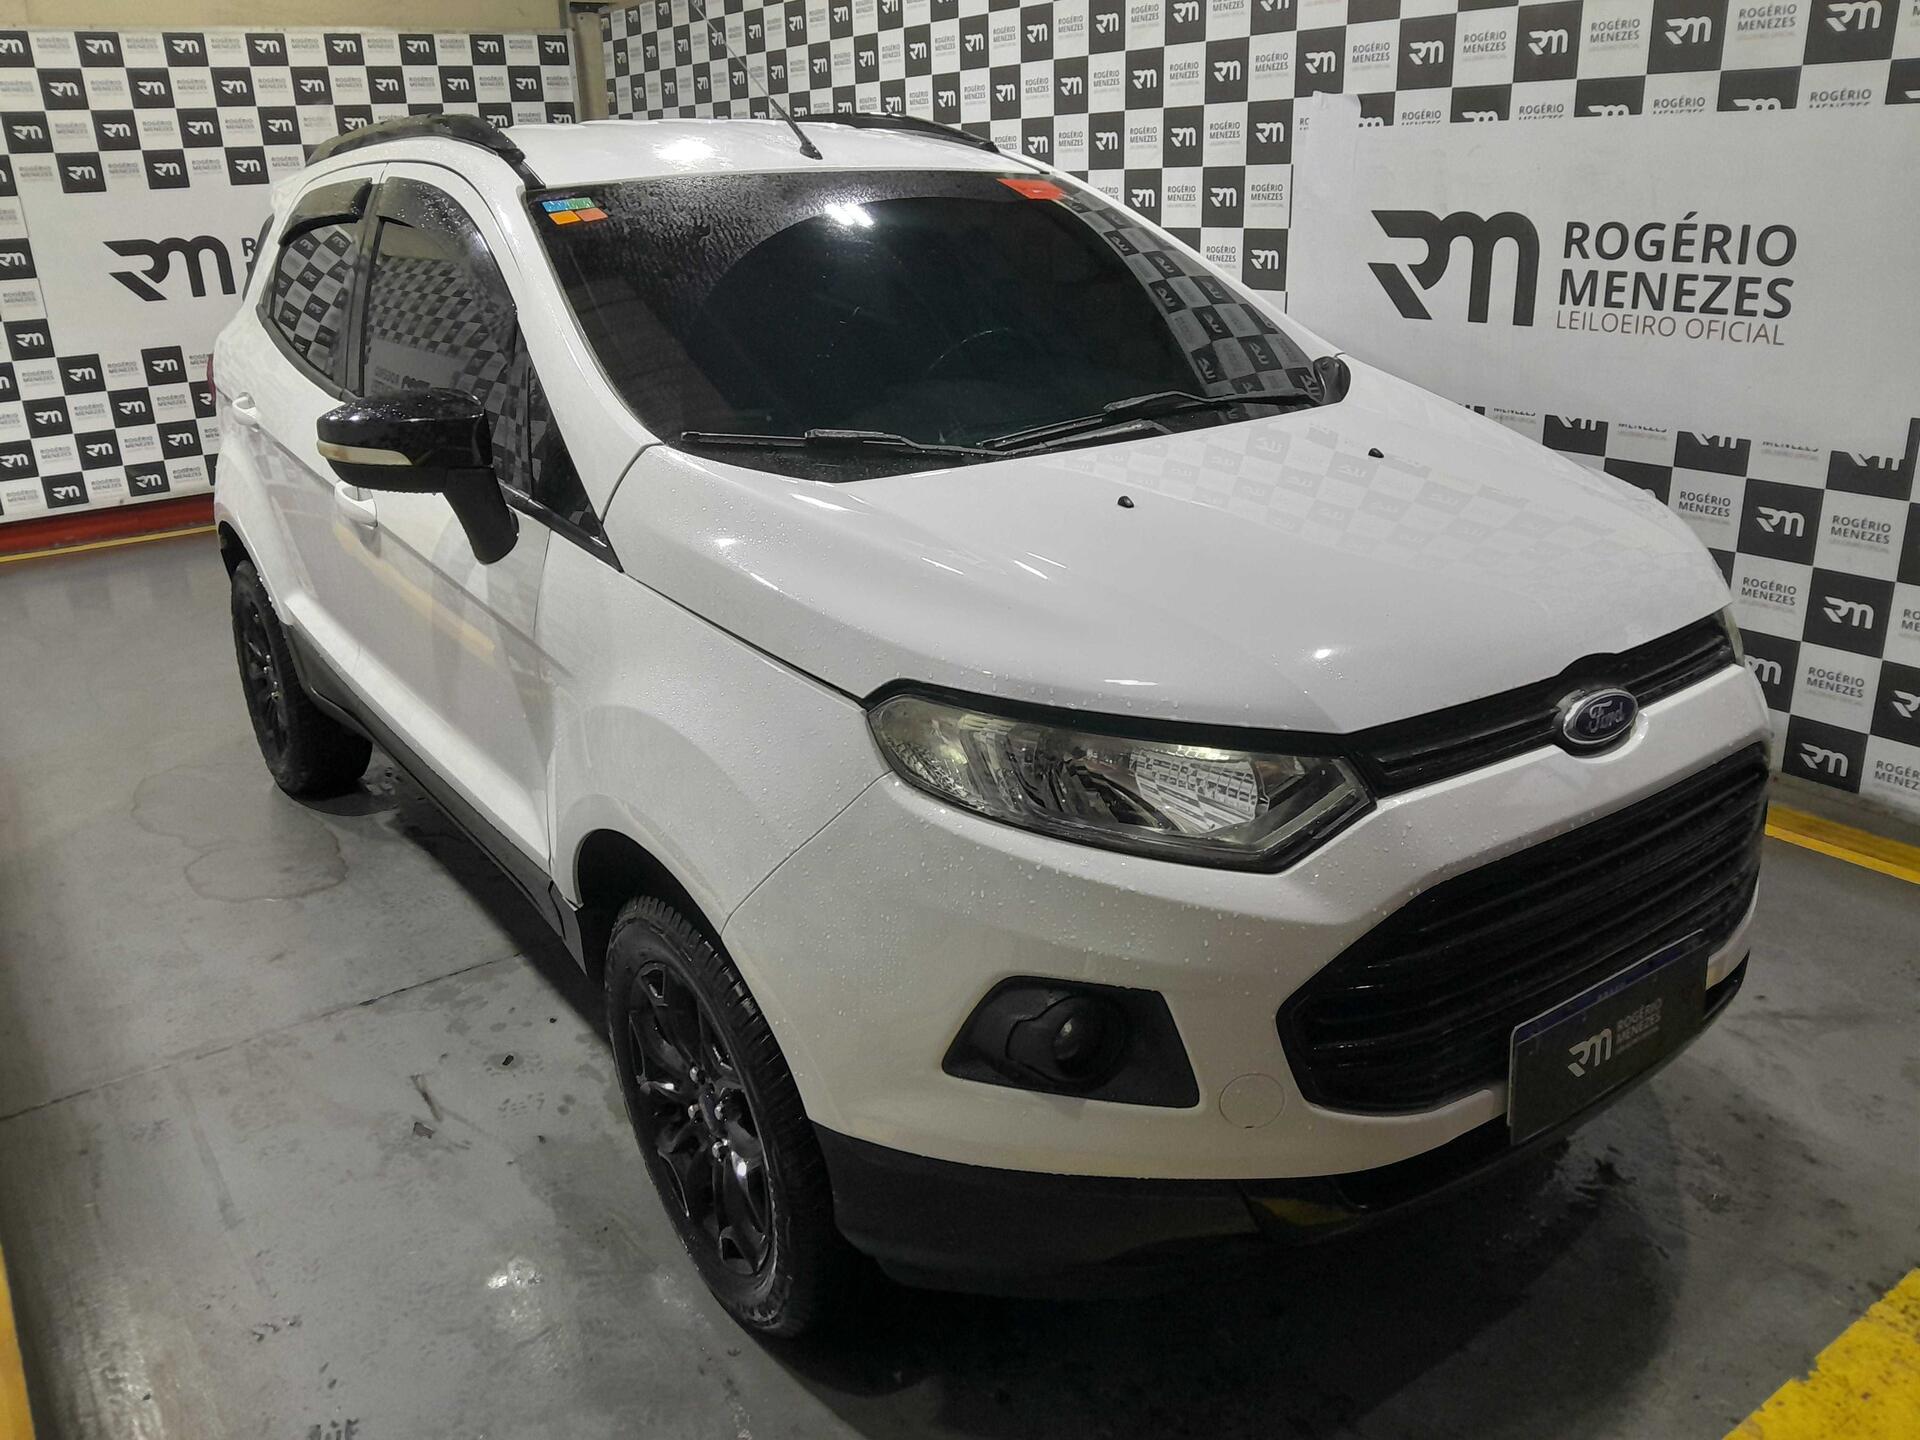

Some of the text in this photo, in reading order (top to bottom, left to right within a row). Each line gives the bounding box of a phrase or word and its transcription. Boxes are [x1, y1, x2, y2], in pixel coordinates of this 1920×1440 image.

[1131, 4, 1159, 14] ROGÉRIO
[1739, 4, 1796, 19] ROGÉRIO
[1058, 15, 1083, 25] ROGÉRIO
[1131, 12, 1159, 23] MENEZES
[1058, 23, 1083, 33] MENEZES
[1591, 18, 1640, 32] ROGÉRIO
[1738, 17, 1796, 31] MENEZES
[993, 26, 1015, 35] ROGÉRIO
[993, 33, 1016, 43] MENEZES
[1464, 31, 1506, 43] ROGÉRIO
[1590, 30, 1639, 44] MENEZES
[1353, 42, 1390, 54] ROGÉRIO
[1463, 42, 1506, 54] MENEZES
[1256, 53, 1288, 63] ROGÉRIO
[1352, 52, 1389, 64] MENEZES
[1170, 62, 1199, 71] ROGÉRIO
[1255, 62, 1288, 72] MENEZES
[1094, 70, 1119, 79] ROGÉRIO
[1170, 70, 1198, 80] MENEZES
[1025, 77, 1048, 86] ROGÉRIO
[1094, 78, 1120, 87] MENEZES
[964, 85, 985, 93] ROGÉRIO
[1026, 85, 1049, 94] MENEZES
[1809, 88, 1872, 102] ROGÉRIO
[964, 92, 986, 100] MENEZES
[1519, 102, 1564, 114] ROGÉRIO
[1653, 97, 1706, 109] ROGÉRIO
[1402, 109, 1441, 120] ROGÉRIO
[1130, 127, 1157, 135] ROGÉRIO
[1210, 122, 1240, 130] ROGÉRIO
[1059, 131, 1083, 139] ROGÉRIO
[1130, 135, 1157, 143] MENEZES
[1210, 131, 1240, 139] MENEZES
[1059, 139, 1083, 147] MENEZES
[1563, 211, 1797, 267] ROGÉRIO
[1206, 246, 1236, 254] ROGÉRIO
[1206, 254, 1236, 262] MENEZES
[103, 235, 236, 301] RM
[1367, 209, 1540, 327] RM
[1559, 268, 1793, 320] MENEZES
[1556, 309, 1785, 346] LEILOEIRO OFICIAL
[0, 453, 29, 468] RM
[1680, 490, 1730, 507] ROGÉRIO
[1678, 501, 1729, 518] MENEZES
[1833, 515, 1891, 534] ROGÉRIO
[1831, 525, 1889, 545] MENEZES
[1743, 576, 1796, 596] ROGÉRIO
[1742, 587, 1795, 605] MENEZES
[1808, 666, 1864, 688] ROGÉRIO
[1806, 676, 1863, 699] MENEZES
[1589, 700, 1624, 733] Ford
[1567, 1028, 1612, 1078] RM
